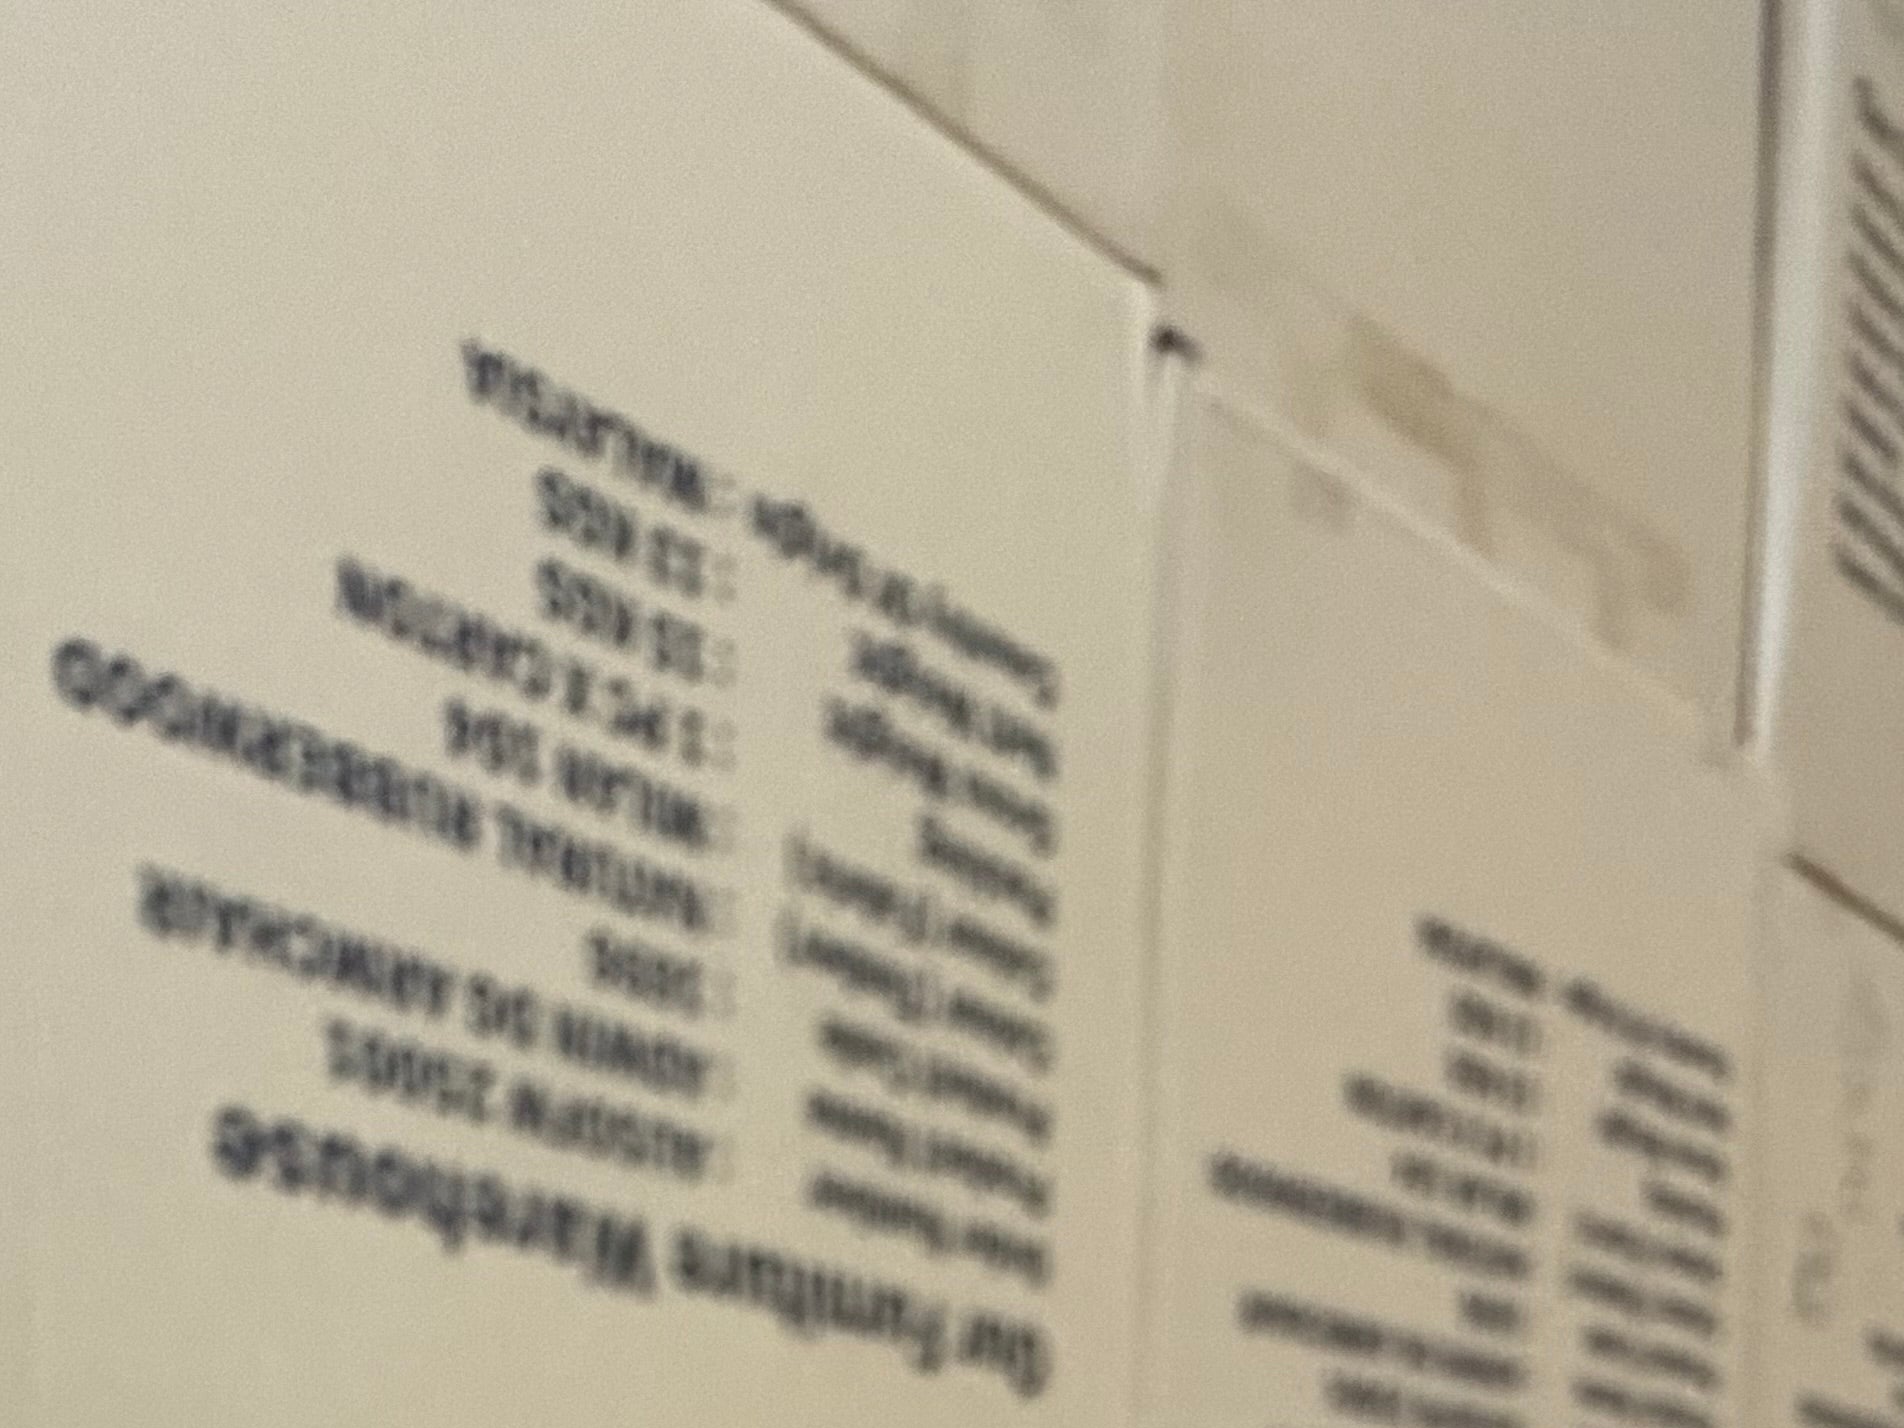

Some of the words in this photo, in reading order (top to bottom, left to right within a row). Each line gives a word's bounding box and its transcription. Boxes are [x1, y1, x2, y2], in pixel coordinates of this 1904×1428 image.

[53, 639, 484, 850] RUBBERWOOD
[136, 861, 454, 1023] ARMCHAIR
[206, 1104, 652, 1300] Warehouse
